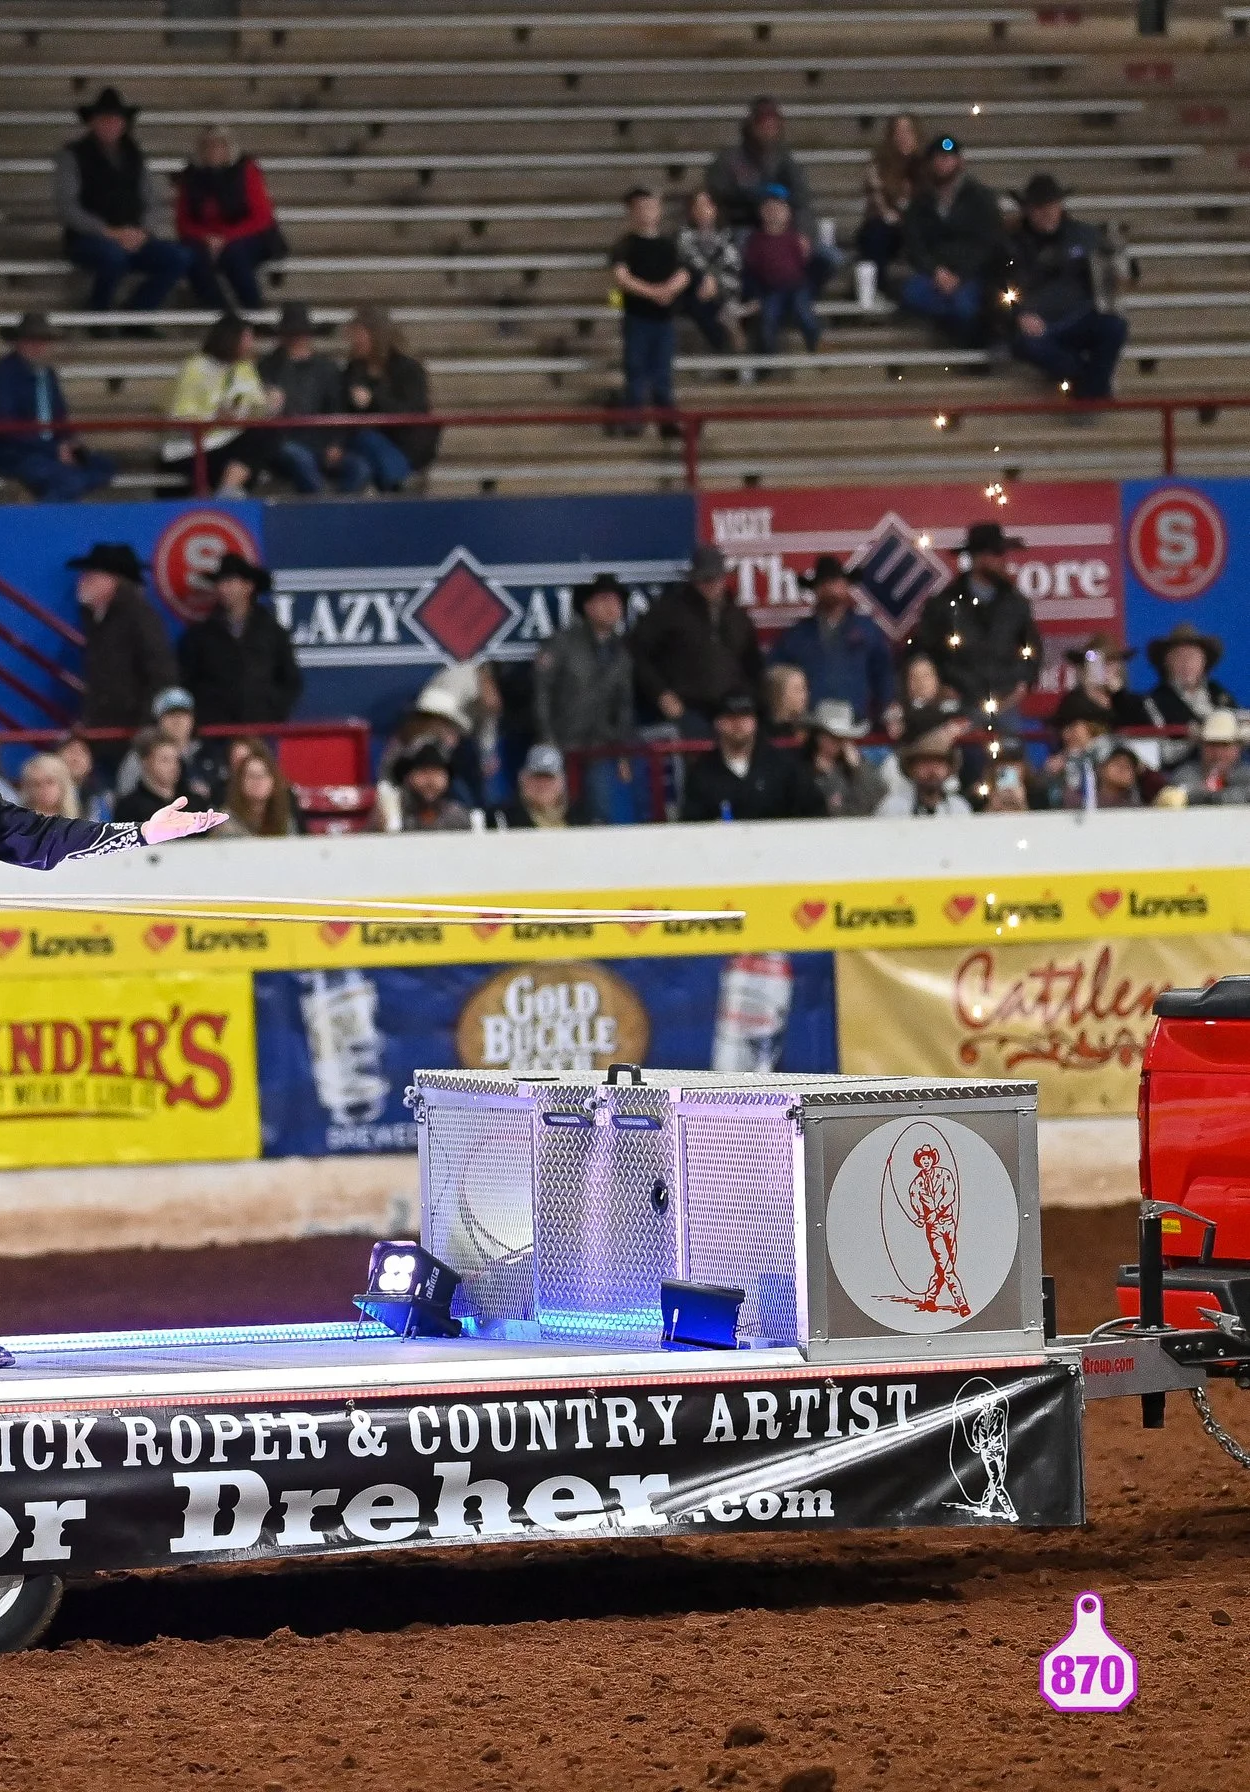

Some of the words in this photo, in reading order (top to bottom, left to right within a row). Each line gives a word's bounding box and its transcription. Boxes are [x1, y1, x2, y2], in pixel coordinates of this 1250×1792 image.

[1157, 511, 1201, 566] S
[724, 555, 817, 605] Th
[119, 1411, 327, 1467] ROPER
[347, 1408, 388, 1457] &
[407, 1394, 684, 1456] COUNTRY
[702, 1383, 918, 1443] ARTIST
[169, 1460, 671, 1554] Dreher
